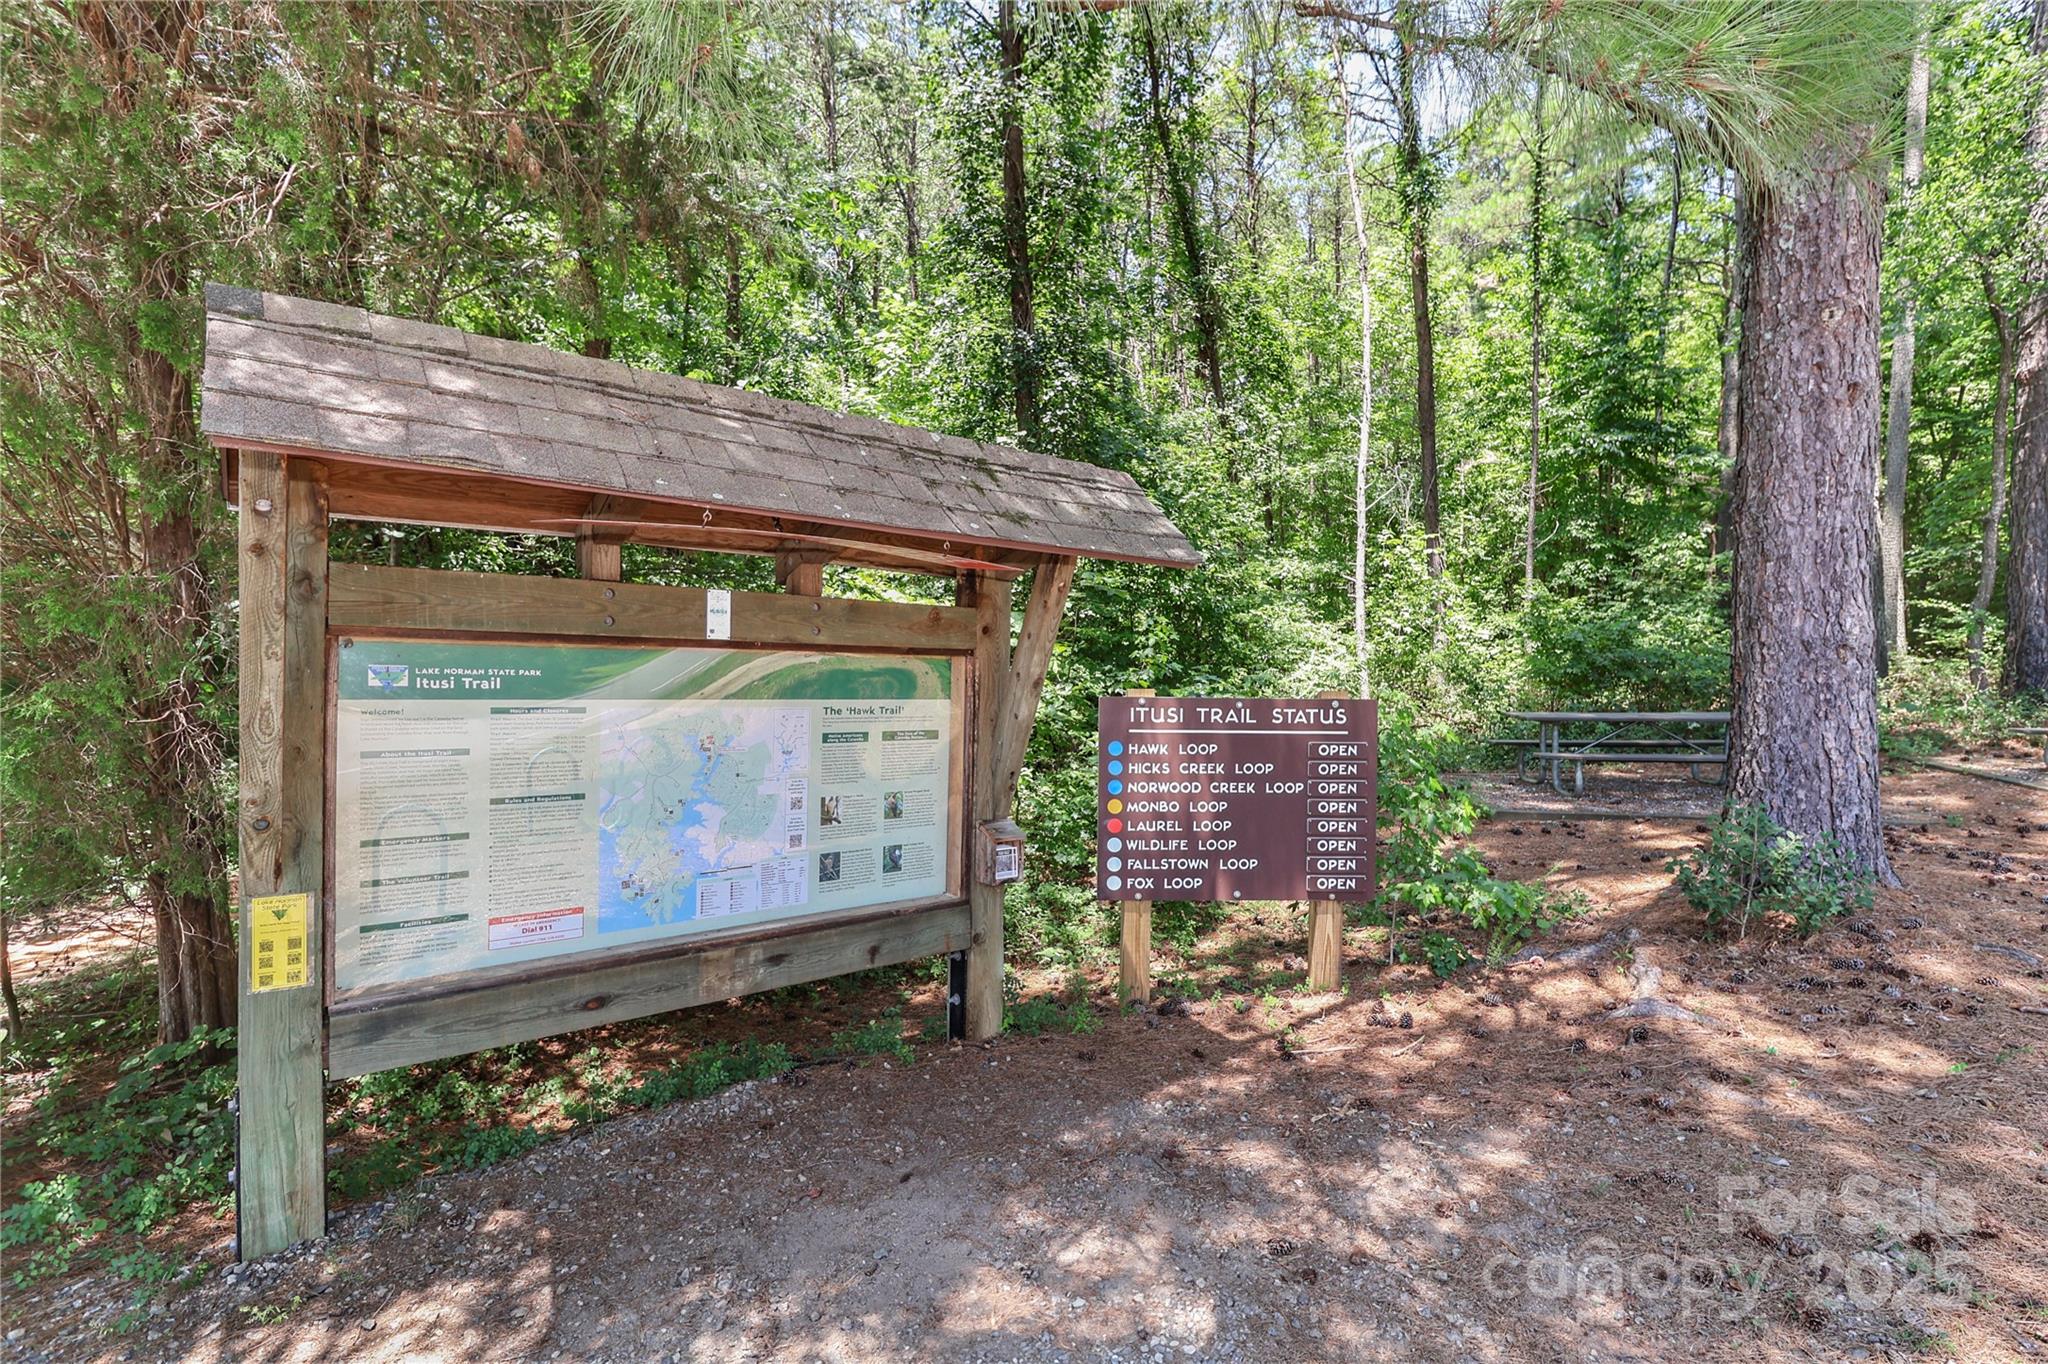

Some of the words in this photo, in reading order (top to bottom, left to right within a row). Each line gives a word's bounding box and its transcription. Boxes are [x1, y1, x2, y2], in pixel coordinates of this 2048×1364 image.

[415, 667, 440, 675] LAKE
[443, 668, 485, 676] NORMAN
[518, 669, 542, 677] PARK
[416, 677, 455, 689] Itusi
[462, 677, 501, 689] Trail
[823, 706, 843, 716] The
[1130, 707, 1184, 724] ITUSI
[1197, 707, 1257, 724] TRAIL
[1272, 707, 1348, 725] STATUS
[1128, 743, 1169, 755] HAWK
[1179, 743, 1218, 755] LOOP
[1318, 745, 1358, 756] OPEN
[1128, 762, 1171, 775] HICKS
[1179, 762, 1225, 775] CREEK
[1235, 762, 1274, 775] LOOP
[1318, 764, 1358, 775] OPEN
[1127, 782, 1202, 794] NORWOOD
[1210, 782, 1256, 794] CREEK
[1265, 782, 1304, 794] LOOP
[1318, 783, 1357, 795] OPEN
[1126, 801, 1180, 813] MONBO
[1189, 801, 1228, 813] LOOP
[1317, 802, 1357, 814] OPEN
[1127, 820, 1183, 832] LAUREL
[1193, 820, 1232, 832] LOOP
[1317, 821, 1357, 833] OPEN
[1126, 839, 1188, 851] WILDLIFE
[1198, 839, 1237, 851] LOOP
[1317, 840, 1356, 852] OPEN
[1127, 858, 1209, 870] FALLSTOWN
[1219, 858, 1258, 870] LOOP
[1317, 859, 1356, 871] OPEN
[1127, 878, 1154, 889] FOX
[1164, 878, 1203, 889] LOOP
[1316, 878, 1356, 890] OPEN
[521, 925, 538, 934] Dial
[539, 924, 553, 932] 911
